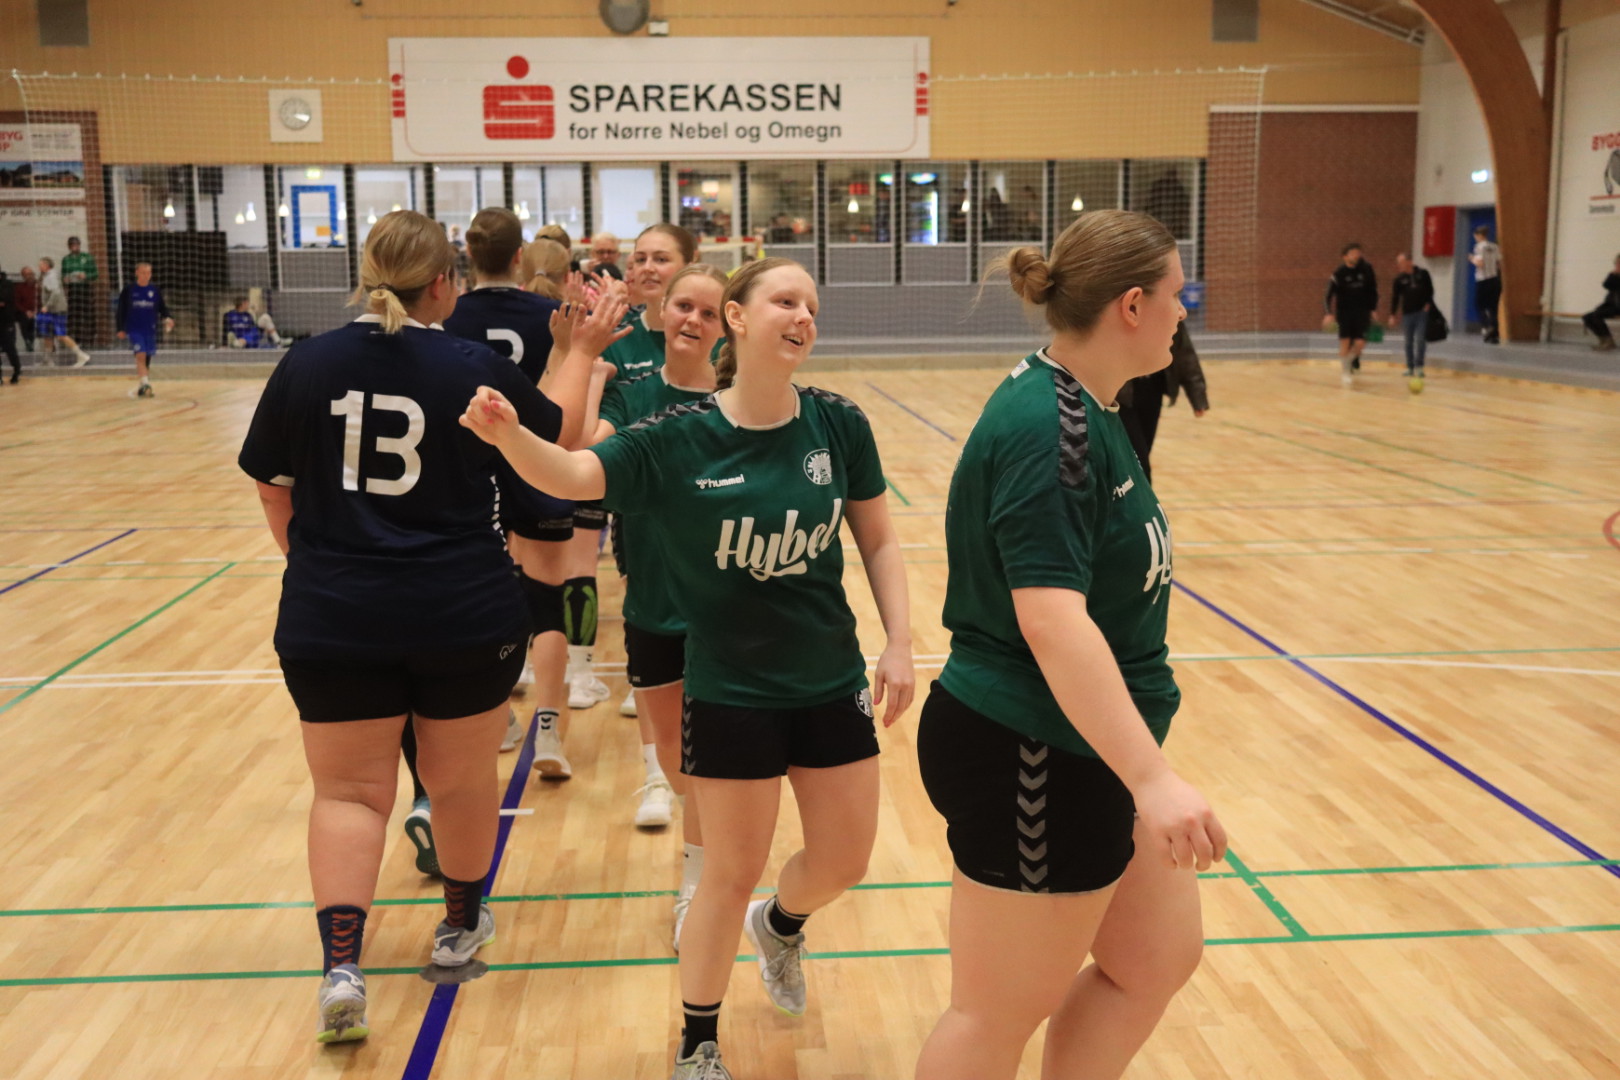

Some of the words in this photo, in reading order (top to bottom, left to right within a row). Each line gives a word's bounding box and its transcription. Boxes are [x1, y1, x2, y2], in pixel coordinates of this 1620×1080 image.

[569, 83, 842, 113] SPAREKASSEN
[569, 123, 597, 139] for
[605, 122, 662, 140] Nørre
[671, 122, 729, 140] Nebel
[735, 126, 761, 143] og
[768, 122, 842, 143] Omegn
[330, 389, 426, 496] 13
[708, 473, 745, 489] hummel
[714, 497, 843, 582] Hybel
